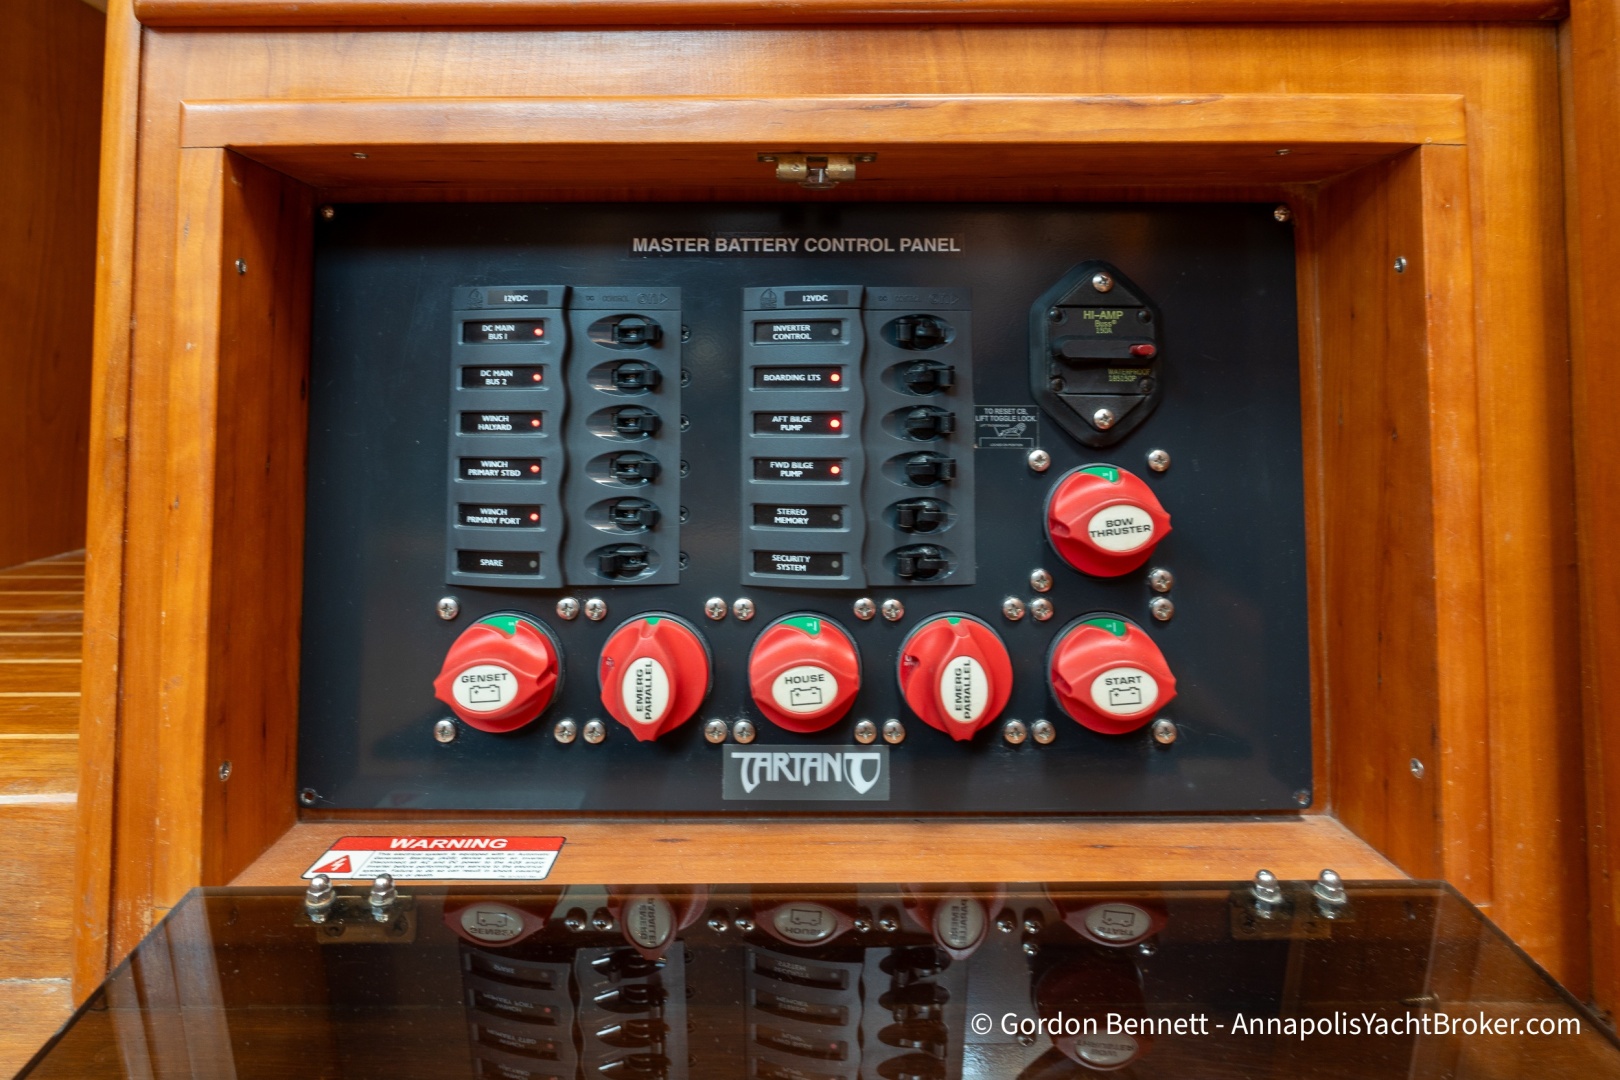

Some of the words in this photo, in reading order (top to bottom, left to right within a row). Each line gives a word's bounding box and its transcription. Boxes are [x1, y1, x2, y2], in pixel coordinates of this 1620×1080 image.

[632, 238, 710, 252] MASTER
[715, 238, 799, 252] BATTERY
[804, 238, 894, 252] CONTROL
[900, 238, 960, 252] PANEL
[504, 294, 528, 302] 12VDC
[802, 294, 828, 302] 12VDC
[1083, 310, 1124, 320] HI-AMP
[1106, 518, 1134, 528] BOW
[1089, 525, 1152, 538] THRUSTER
[461, 673, 508, 683] GENSET
[785, 674, 825, 685] HOUSE
[1105, 676, 1142, 686] START
[390, 838, 508, 849] WARNING
